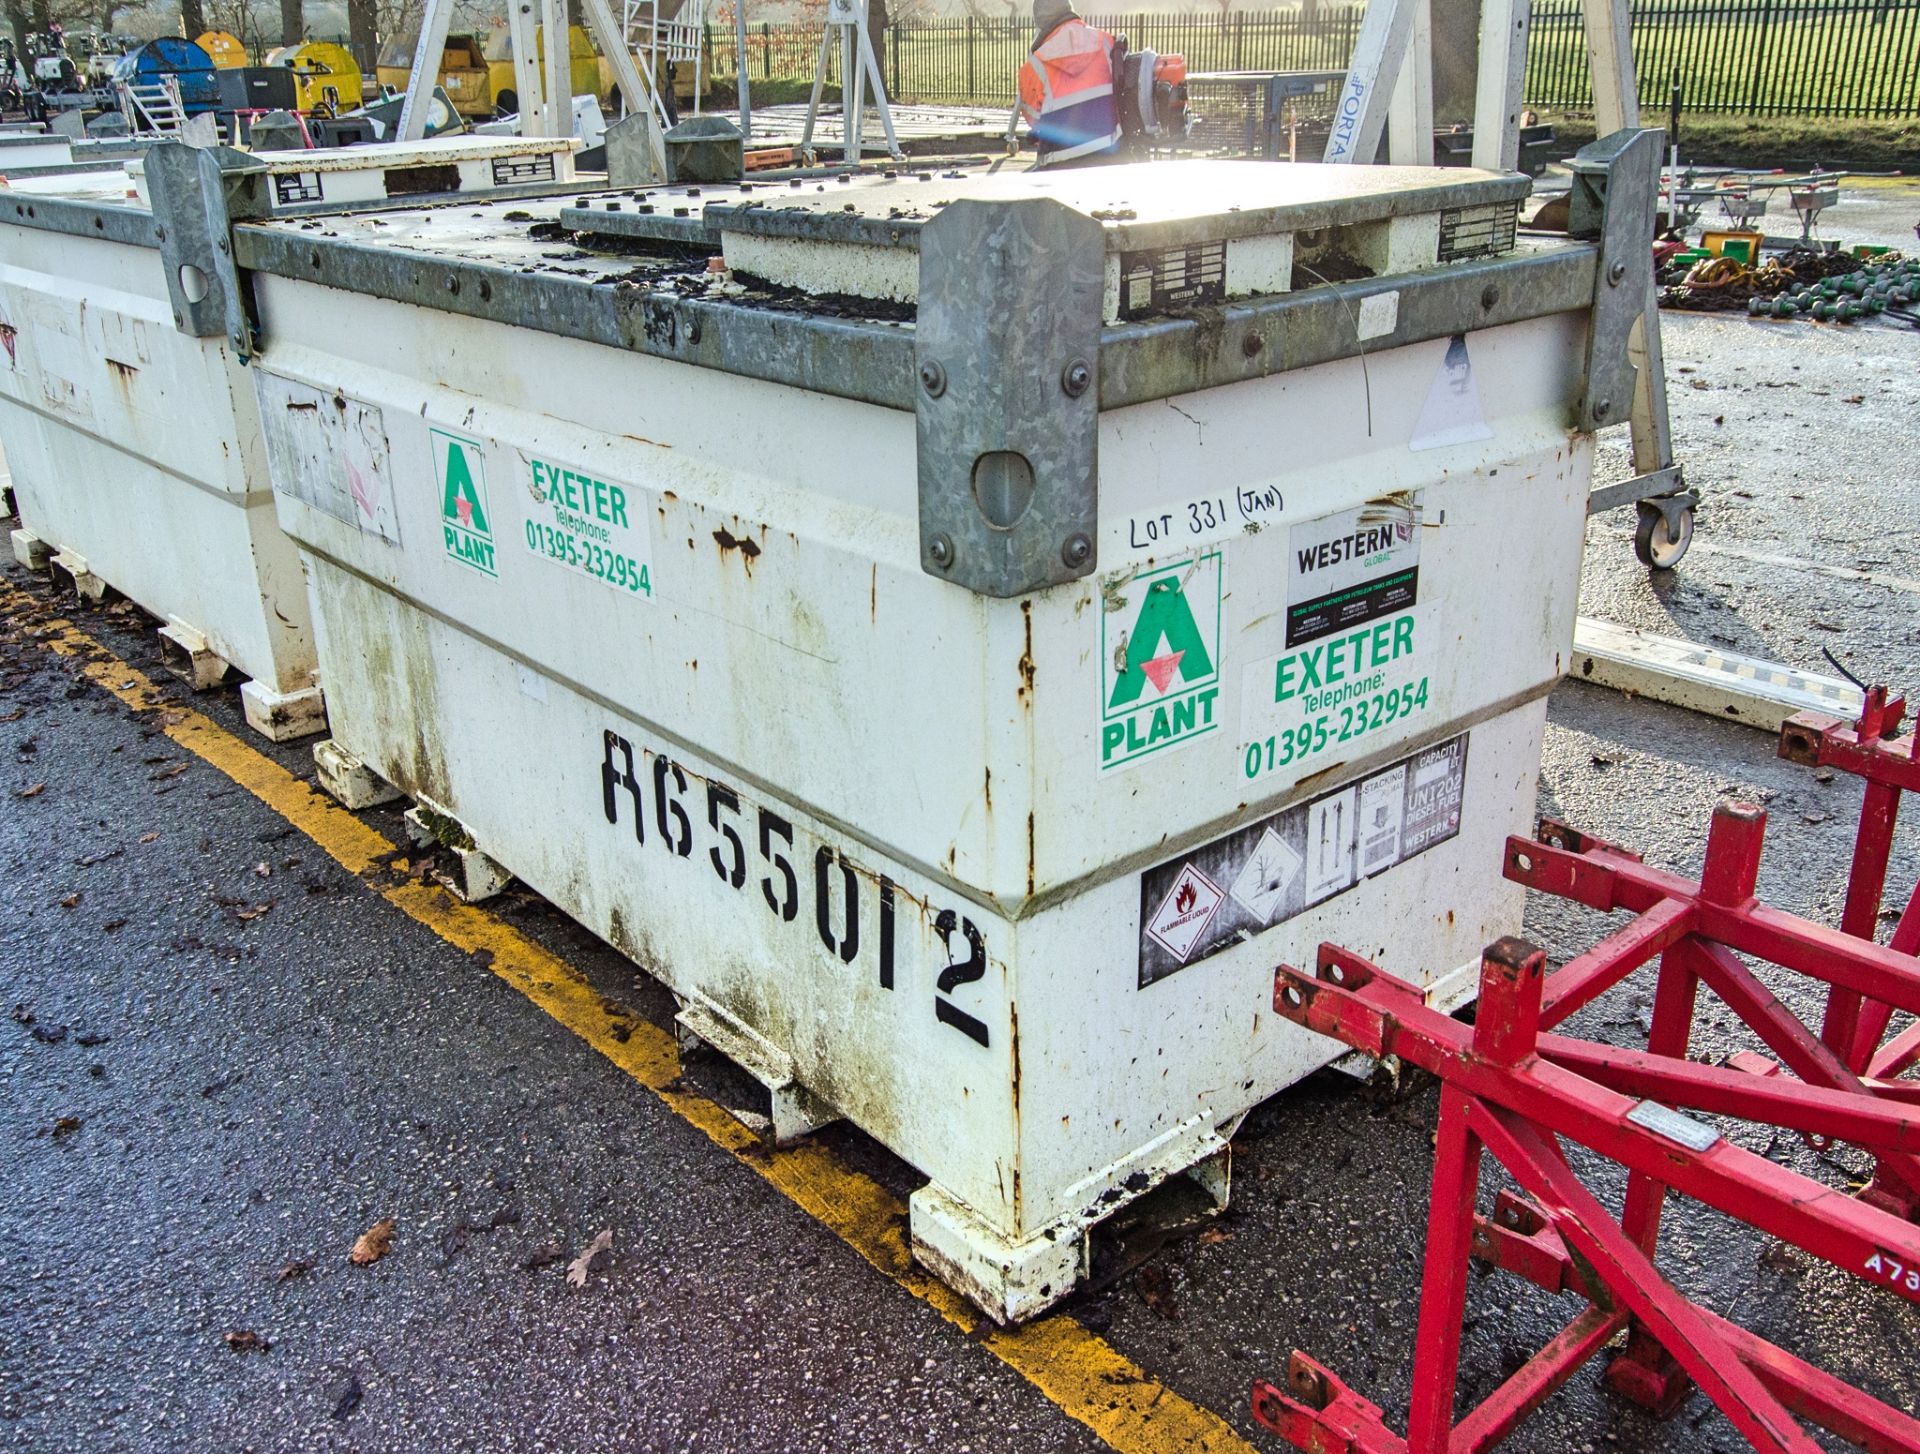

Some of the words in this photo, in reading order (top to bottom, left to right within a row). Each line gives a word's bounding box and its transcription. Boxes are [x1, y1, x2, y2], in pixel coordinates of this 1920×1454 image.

[531, 459, 630, 530] EXETER
[553, 505, 612, 545] Telephone:
[1131, 515, 1172, 548] LOT
[1188, 499, 1226, 533] 331
[1237, 485, 1283, 522] (JAN)
[443, 526, 496, 570] PLANT
[526, 519, 652, 597] 01395-232954
[1297, 524, 1393, 574] WESTERN
[1363, 552, 1391, 568] GLOBAL
[1275, 615, 1415, 703] EXETER
[1302, 672, 1386, 715] Telephone:
[1102, 687, 1219, 762] PLANT
[1245, 677, 1429, 779] 01395-232954
[1420, 742, 1459, 768] CAPACITY
[1364, 770, 1403, 794] STACKING
[1406, 801, 1436, 825] DIESEL
[1438, 792, 1460, 810] FUEL
[1405, 819, 1448, 850] WESTERN
[1160, 916, 1192, 934] FLAMMABLE
[1192, 905, 1210, 919] LIQUID
